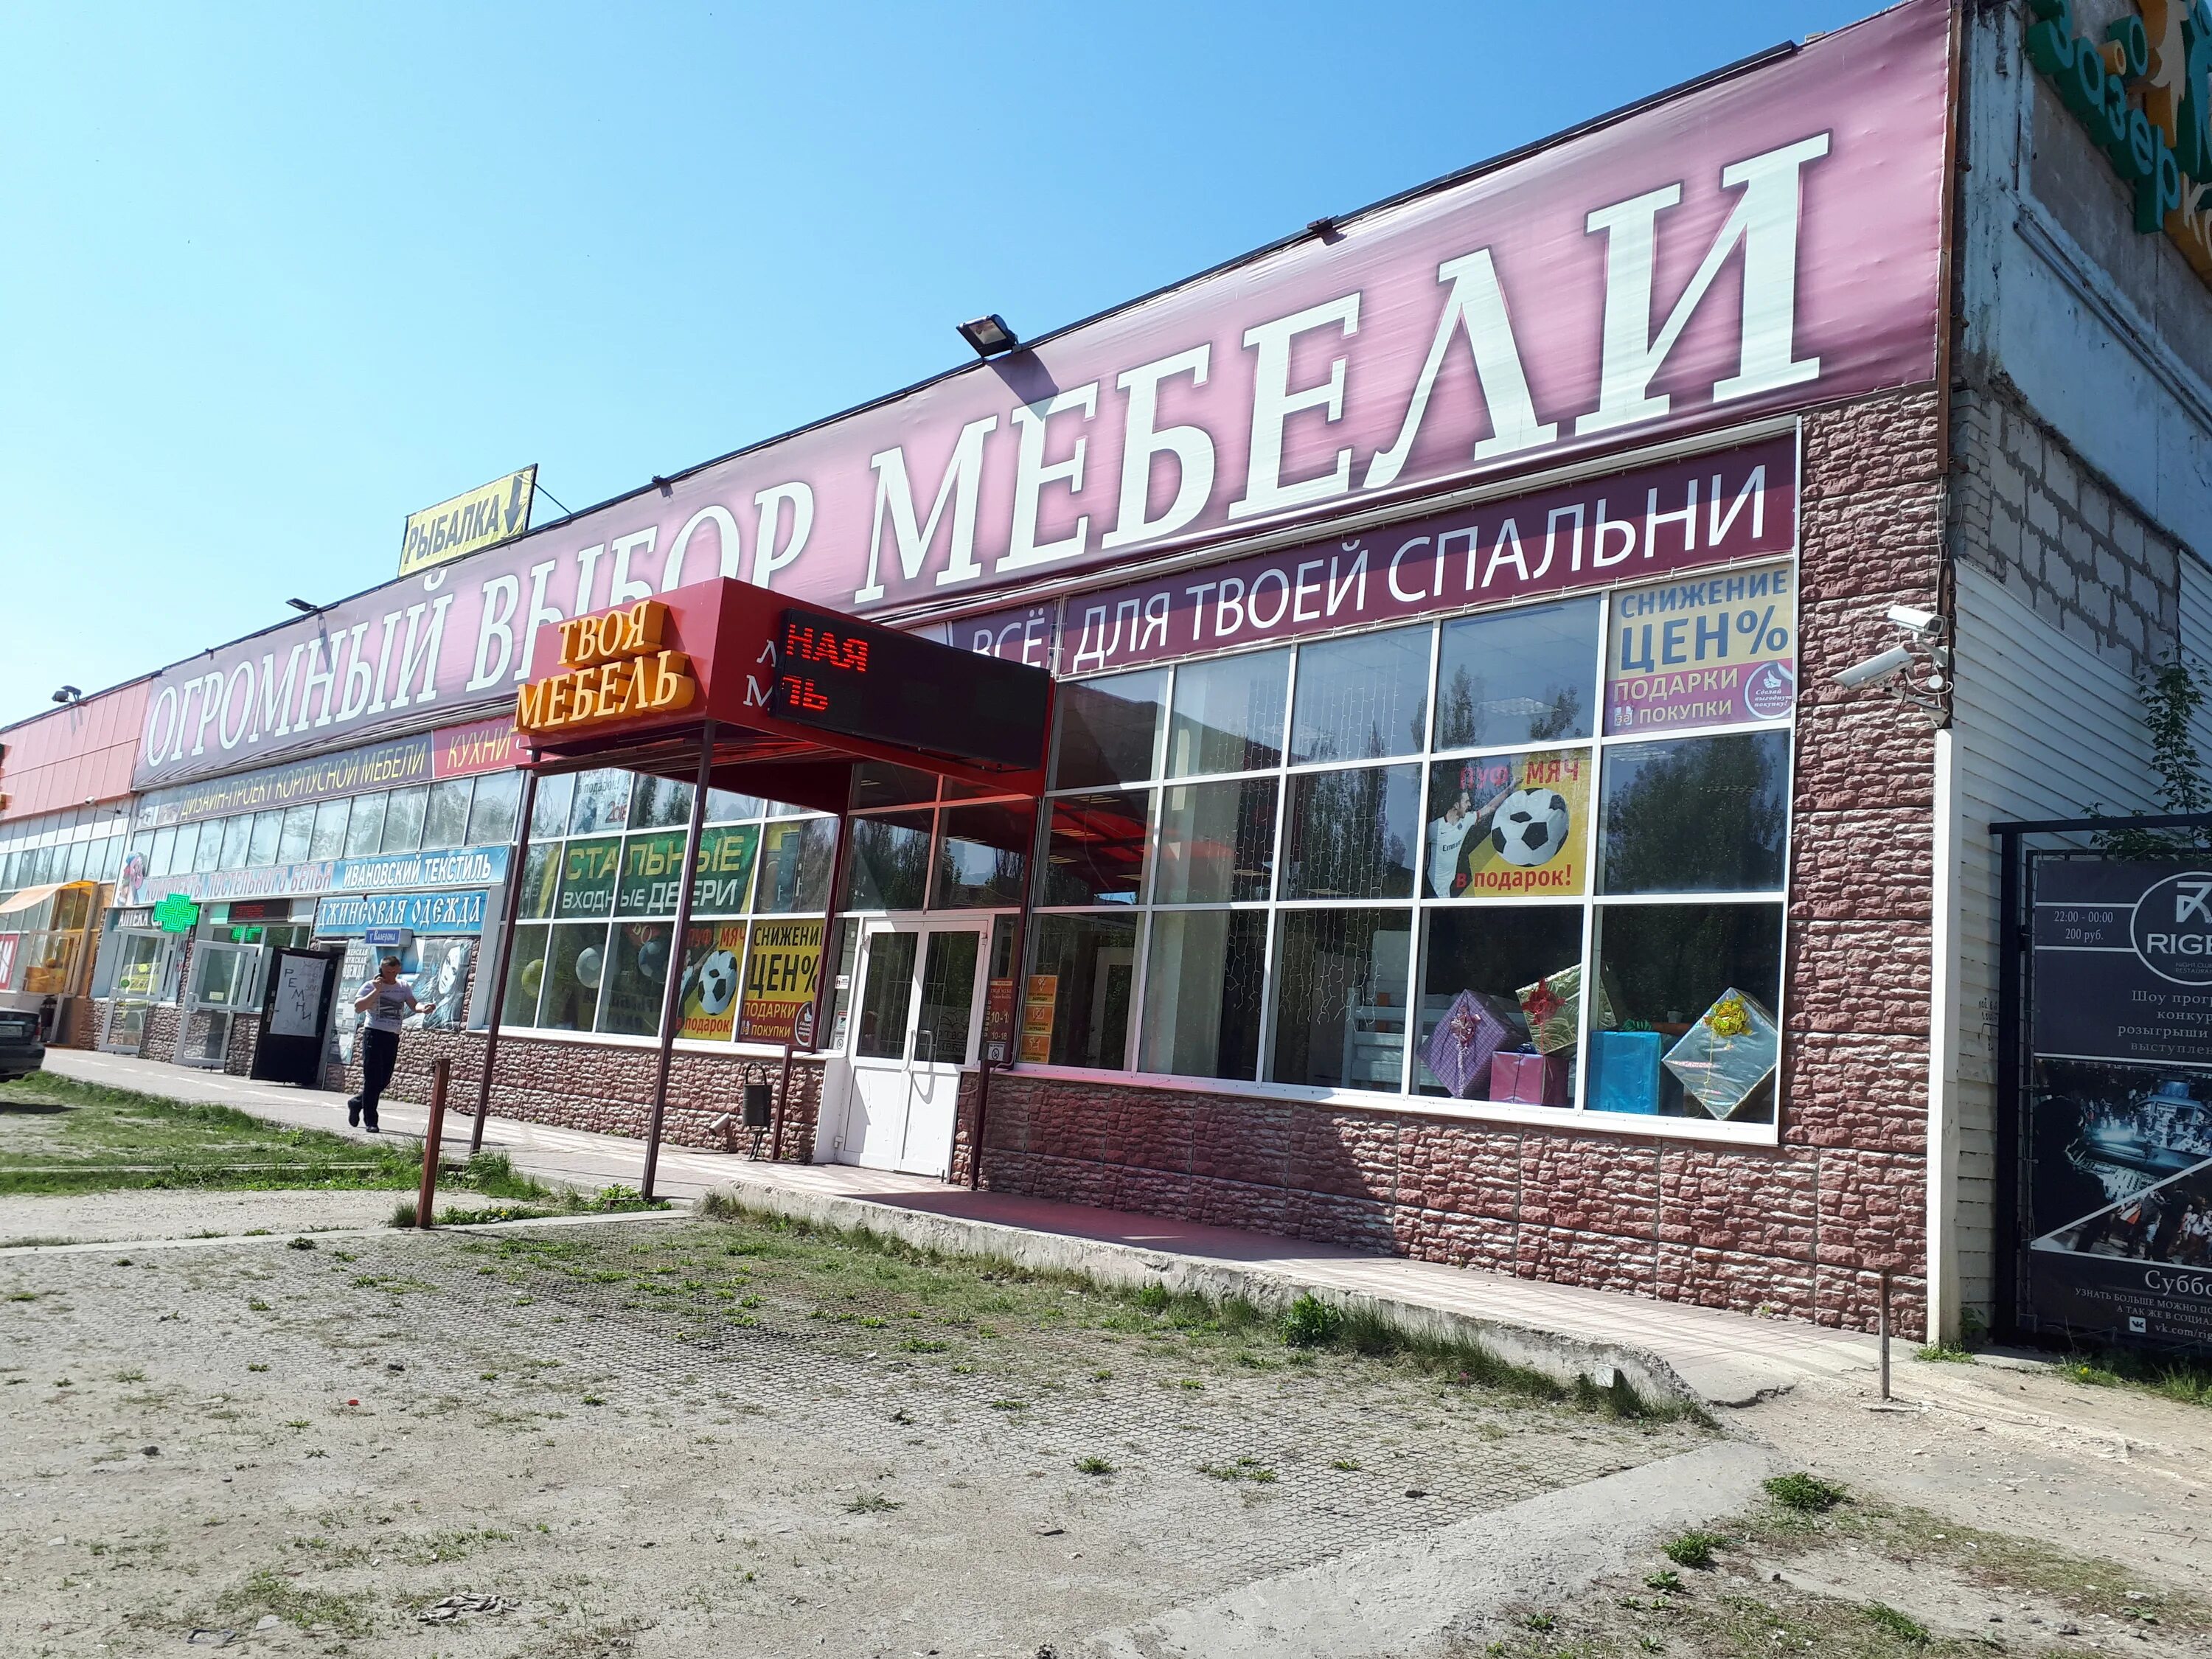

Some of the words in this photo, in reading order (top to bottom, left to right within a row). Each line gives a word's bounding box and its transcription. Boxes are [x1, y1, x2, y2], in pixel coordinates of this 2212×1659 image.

[146, 568, 454, 768] ОГРОМНЫЙ
[855, 130, 1832, 603] МЕБЕЛИ
[404, 494, 500, 565] РЫБАЛКА
[973, 608, 1045, 667] ВСЁ
[1071, 592, 1171, 674] ДЛЯ
[1186, 540, 1368, 640] ТВОЕЙ
[1388, 465, 1767, 602] СПАЛЬНИ
[1621, 568, 1788, 619] СНИЖЕНИЕ
[557, 599, 651, 665] ТВОЯ
[786, 623, 869, 672] НАЯ
[1621, 605, 1789, 673] ЦЕН%
[510, 650, 679, 732] МЕБЕЛЬ
[1613, 668, 1739, 702] ПОДАРКИ
[1639, 699, 1733, 724] ПОКУПКИ
[446, 725, 513, 769] КУХНИ
[179, 773, 277, 820] ДИЗАЙН-ПРОЕКТ
[274, 751, 359, 799] КОРПУСНОЙ
[360, 742, 427, 784] МЕБЕЛИ
[1459, 765, 1509, 790] ПУФ
[1526, 758, 1579, 785] МЯЧ
[342, 853, 422, 888] ИВАНОВСКИЙ
[424, 854, 493, 883] ТЕКСТИЛЬ
[565, 835, 745, 881] СТАЛЬНЫЕ
[206, 866, 288, 897] ПОСТЕЛЬНОГО
[290, 862, 333, 892] БЕЛЬЯ
[1475, 864, 1572, 892] подарок!
[317, 898, 408, 929] ДЖИНСОВАЯ
[411, 896, 482, 931] ОДЕЖДА
[562, 887, 646, 913] ВХОДНЫЕ
[646, 879, 738, 914] ДВЕРИ
[118, 911, 148, 927] АПТЕКА
[2054, 911, 2079, 922] 22:00
[2088, 911, 2113, 923] 00:00
[720, 927, 745, 947] МЯЧ
[2065, 928, 2081, 940] 200
[2084, 929, 2104, 943] руб.
[343, 964, 366, 981] ОДЕЖДА
[742, 1002, 796, 1020] ПОДАРКИ
[2132, 990, 2166, 1005] Шоу
[751, 1024, 791, 1037] ПОКУПКИ
[2118, 1026, 2209, 1040] розыгрыши
[2076, 1288, 2112, 1300] УЗНАТЬ
[2114, 1293, 2155, 1306] БОЛЬШЕ
[2157, 1299, 2197, 1312] МОЖНО
[2125, 1306, 2146, 1316] ТАК
[2148, 1310, 2163, 1318] ЖЕ
